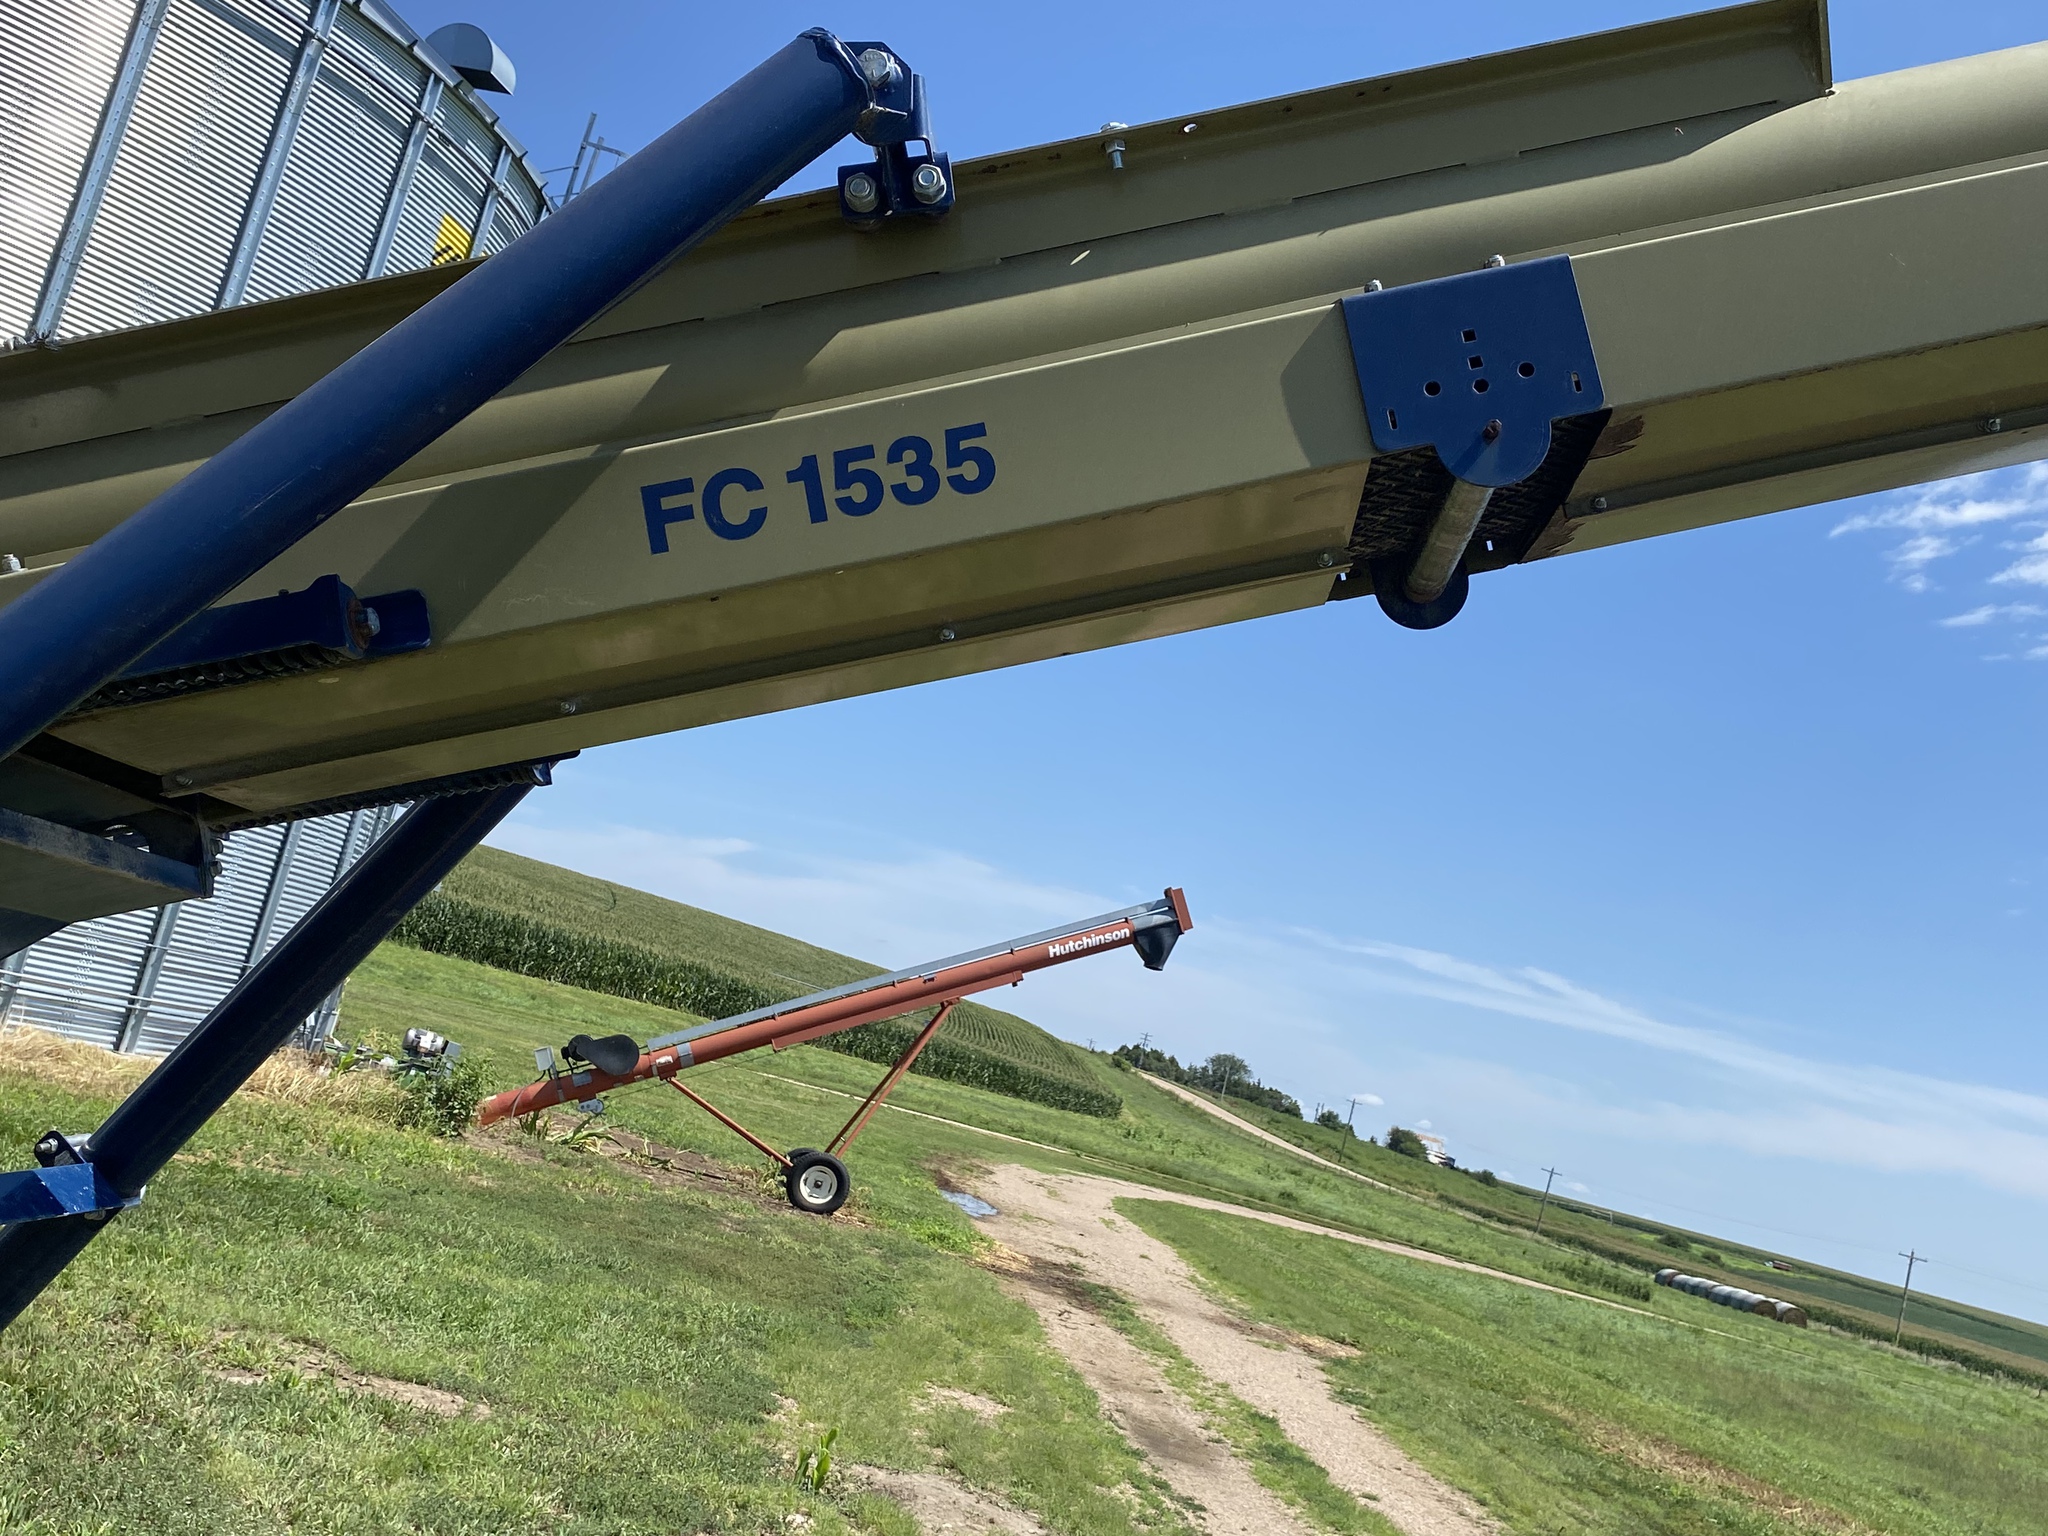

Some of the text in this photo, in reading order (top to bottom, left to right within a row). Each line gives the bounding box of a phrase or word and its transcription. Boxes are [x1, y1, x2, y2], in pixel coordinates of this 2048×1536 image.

[640, 422, 996, 555] FC 1535
[1048, 927, 1130, 958] Hutchinson
